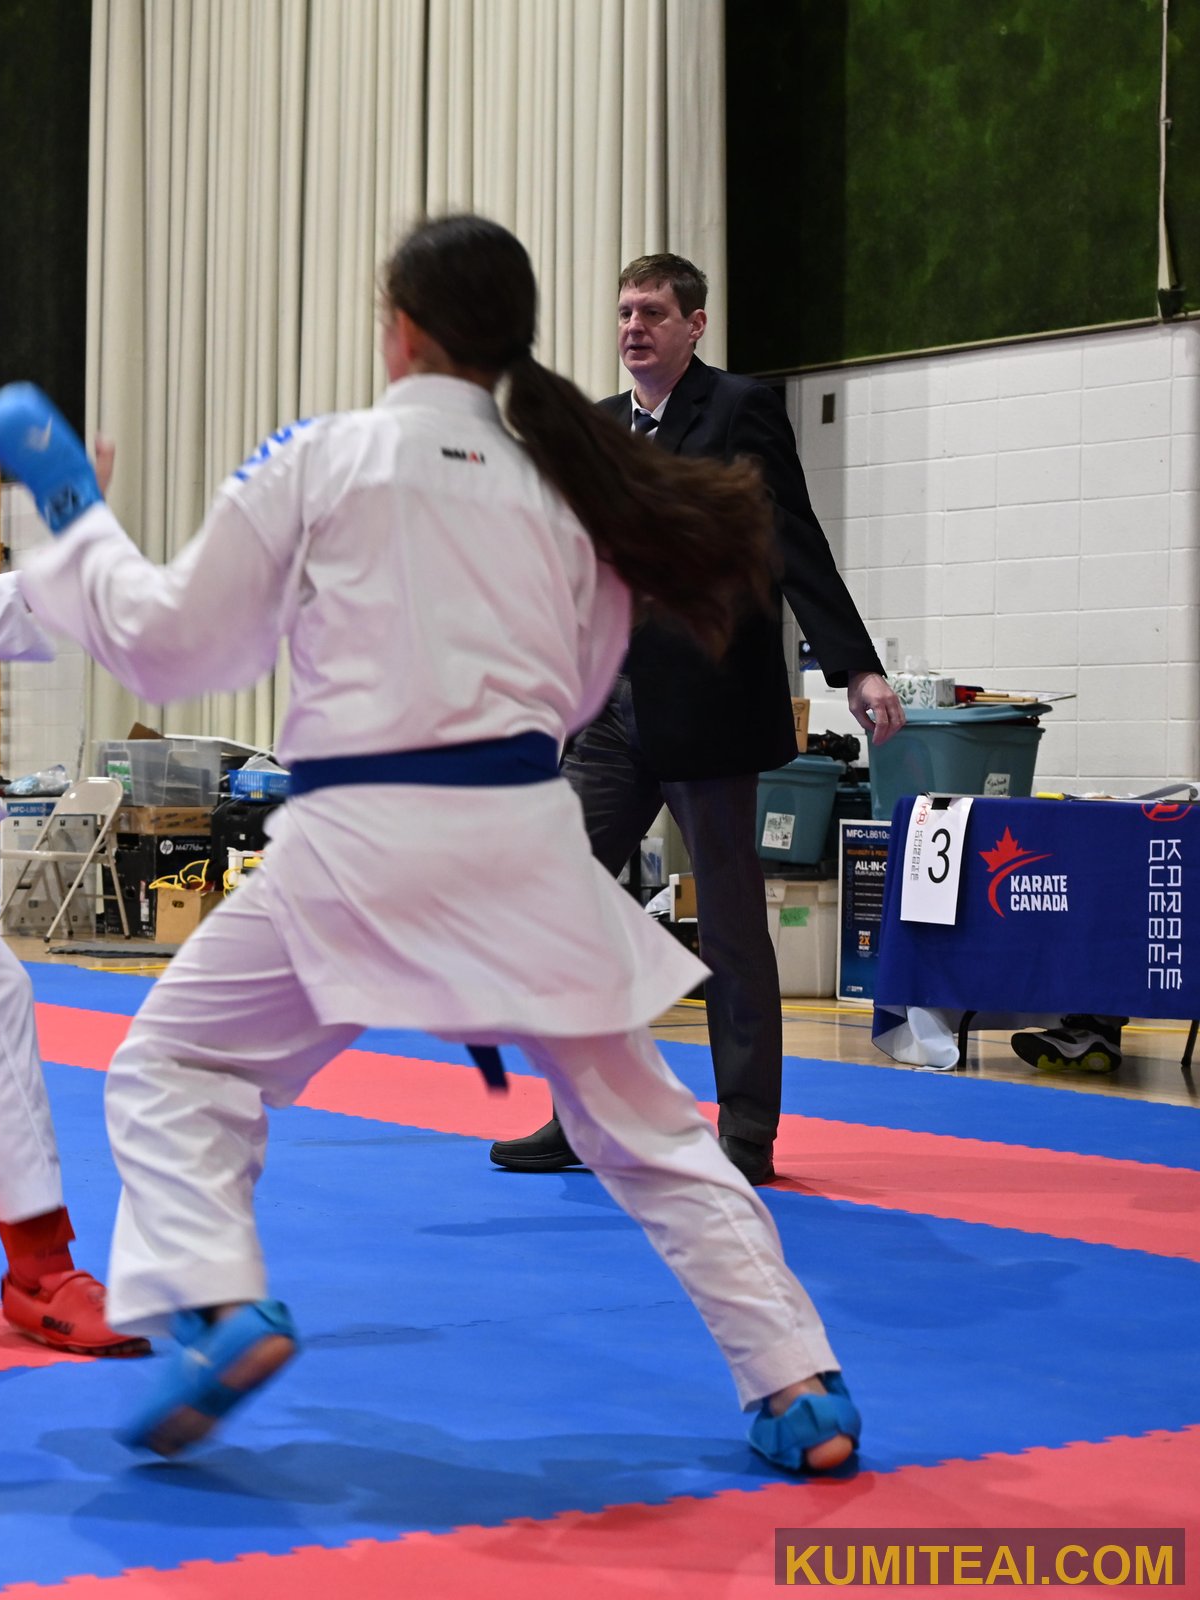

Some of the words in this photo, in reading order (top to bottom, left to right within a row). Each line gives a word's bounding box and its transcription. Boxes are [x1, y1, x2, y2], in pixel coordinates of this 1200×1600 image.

[160, 840, 174, 855] hp
[928, 828, 951, 883] 3
[1010, 875, 1067, 892] KARATE
[1010, 894, 1068, 911] CANADA
